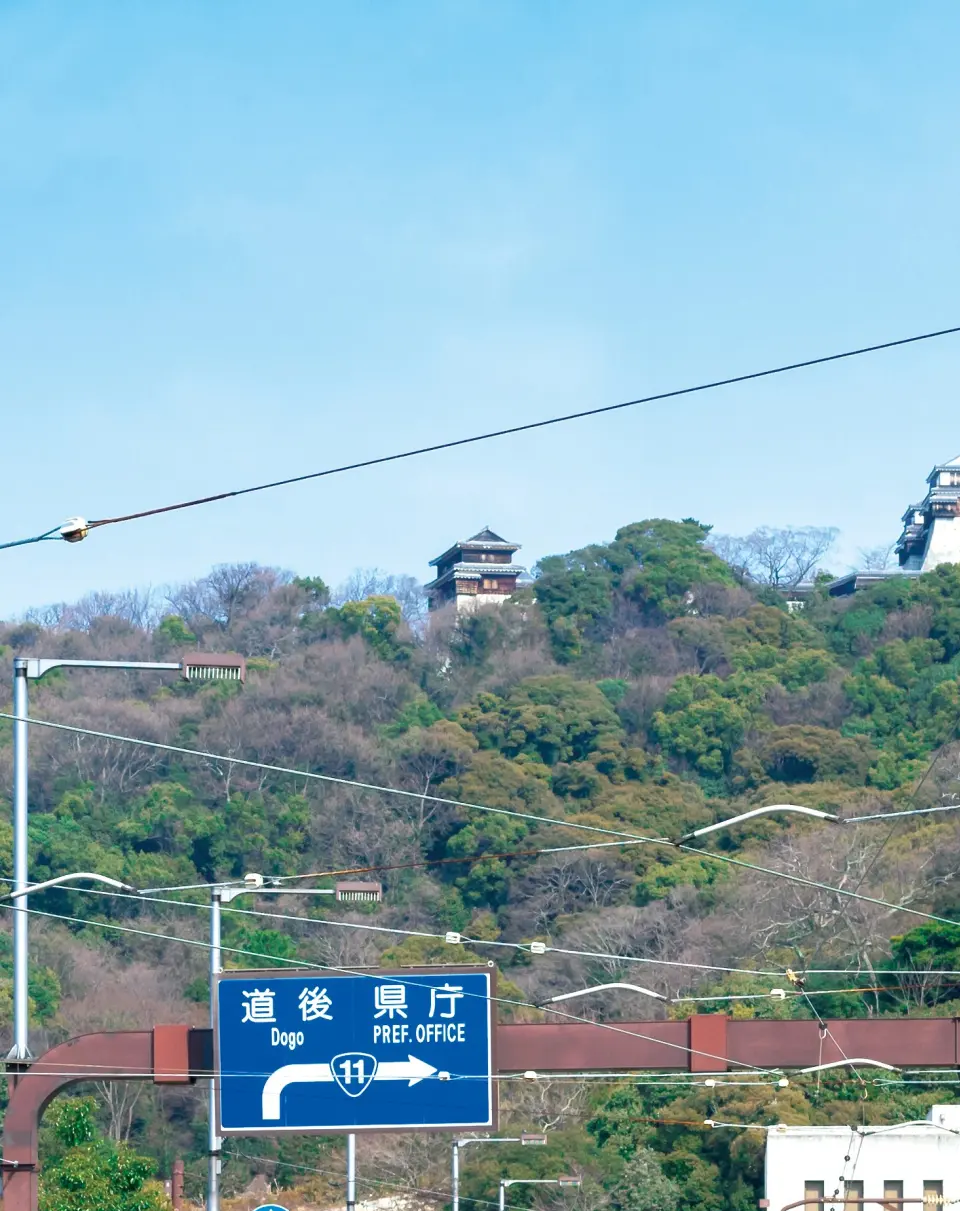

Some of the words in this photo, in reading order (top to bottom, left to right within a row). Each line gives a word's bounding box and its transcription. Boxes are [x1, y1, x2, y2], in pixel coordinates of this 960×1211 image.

[241, 986, 334, 1024] 道後
[373, 983, 464, 1019] 県庁
[271, 1027, 305, 1050] Dogo
[373, 1024, 412, 1044] PREF.
[415, 1023, 466, 1043] OFFICE
[339, 1059, 365, 1085] 11
